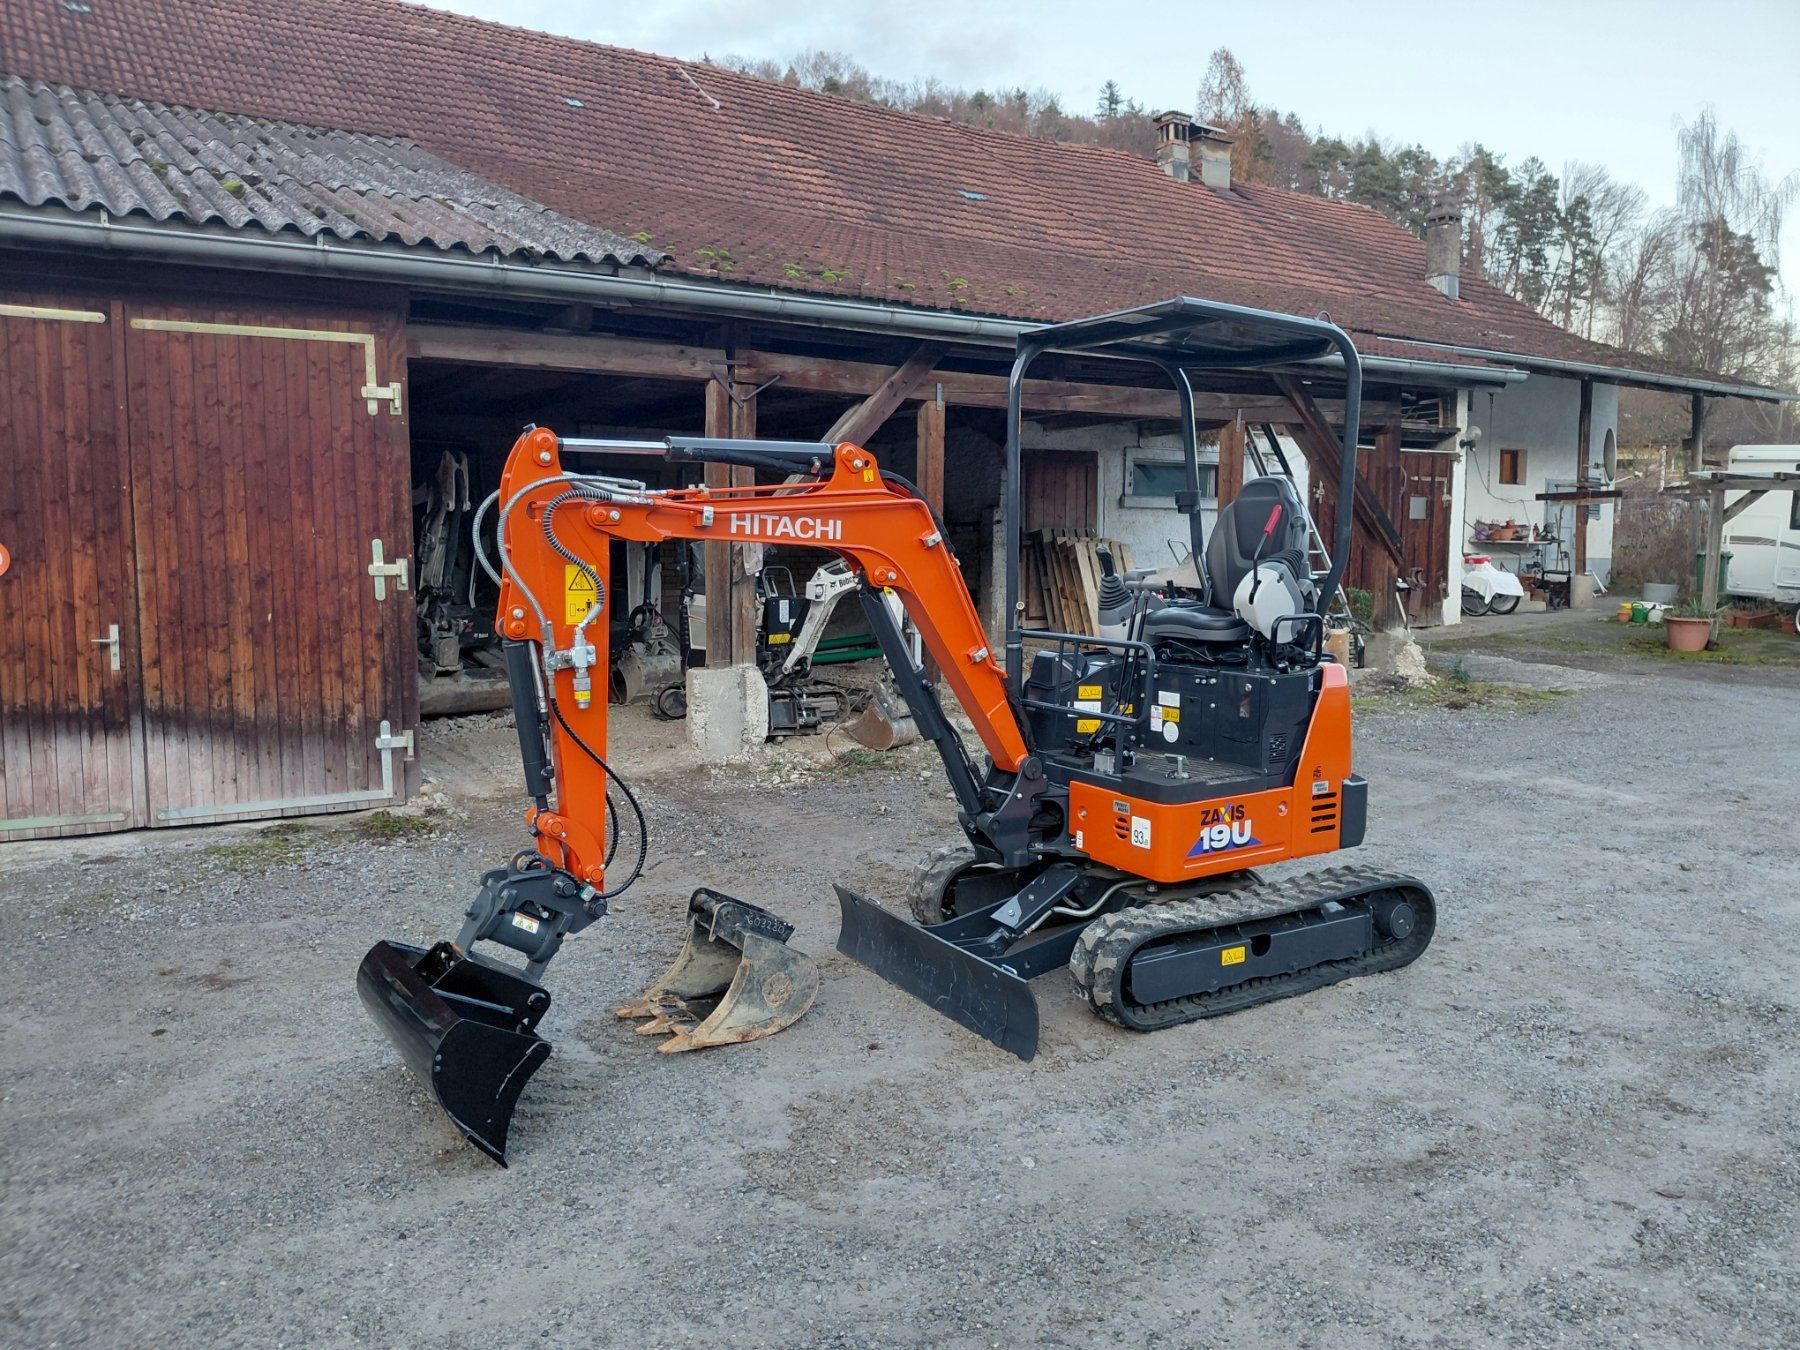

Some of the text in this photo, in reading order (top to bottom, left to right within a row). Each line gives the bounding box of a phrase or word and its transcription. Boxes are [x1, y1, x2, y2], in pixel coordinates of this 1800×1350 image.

[730, 513, 842, 540] HITACHI
[1200, 802, 1245, 826] ZAXIS
[1133, 829, 1144, 845] 93
[1200, 819, 1252, 852] 19U
